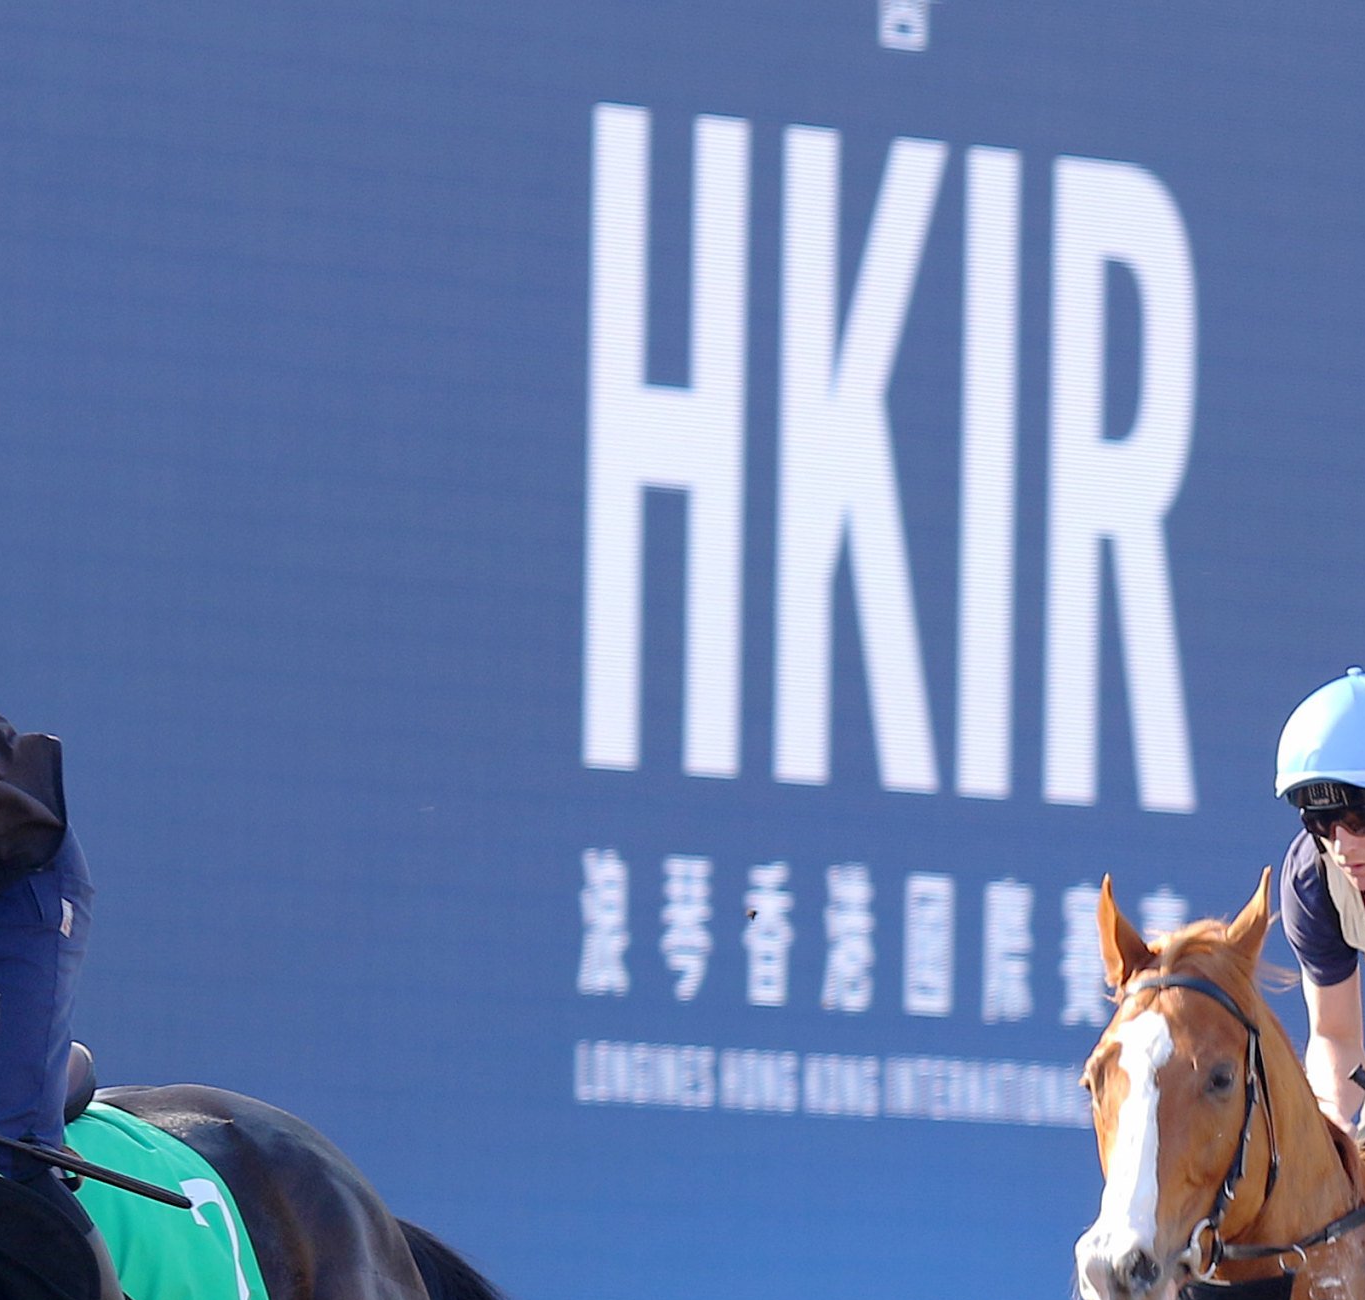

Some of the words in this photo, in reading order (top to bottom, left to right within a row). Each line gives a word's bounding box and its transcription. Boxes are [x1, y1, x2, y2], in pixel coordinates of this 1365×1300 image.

[582, 101, 1200, 813] HKIR
[577, 848, 1188, 1027] 浪琴香港國際賽
[575, 1040, 716, 1110] LONGINES
[720, 1047, 798, 1114] HONG
[803, 1052, 879, 1118] KONG
